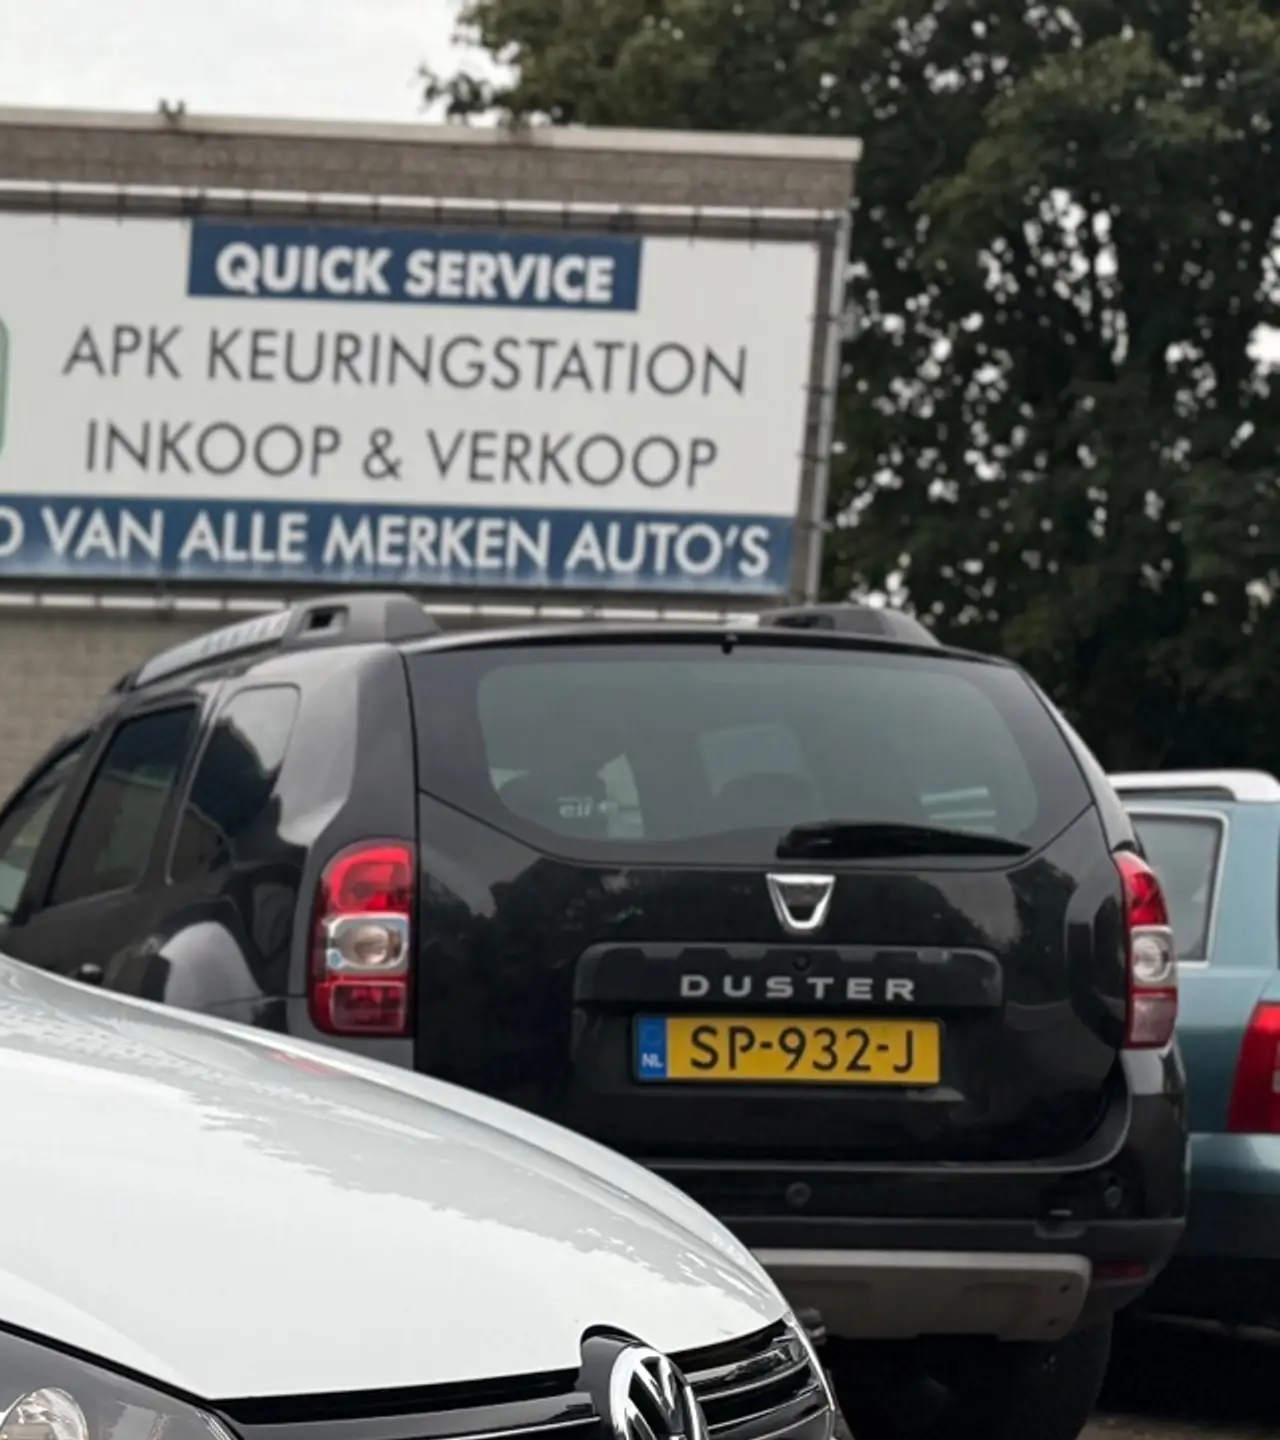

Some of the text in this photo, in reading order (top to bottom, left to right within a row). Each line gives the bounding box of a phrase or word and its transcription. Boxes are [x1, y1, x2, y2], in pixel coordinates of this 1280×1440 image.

[216, 242, 614, 303] QUICK SERVICE
[62, 325, 746, 397] APK KEURINGSTATION
[86, 419, 717, 489] INKOOP & VERKOOP
[41, 507, 165, 560] VAN
[179, 511, 309, 564] ALLE
[323, 515, 551, 569] MERKEN
[564, 521, 771, 577] AUTO'S
[680, 975, 914, 1001] DUSTER
[642, 1025, 913, 1074] NL SP-932-J
